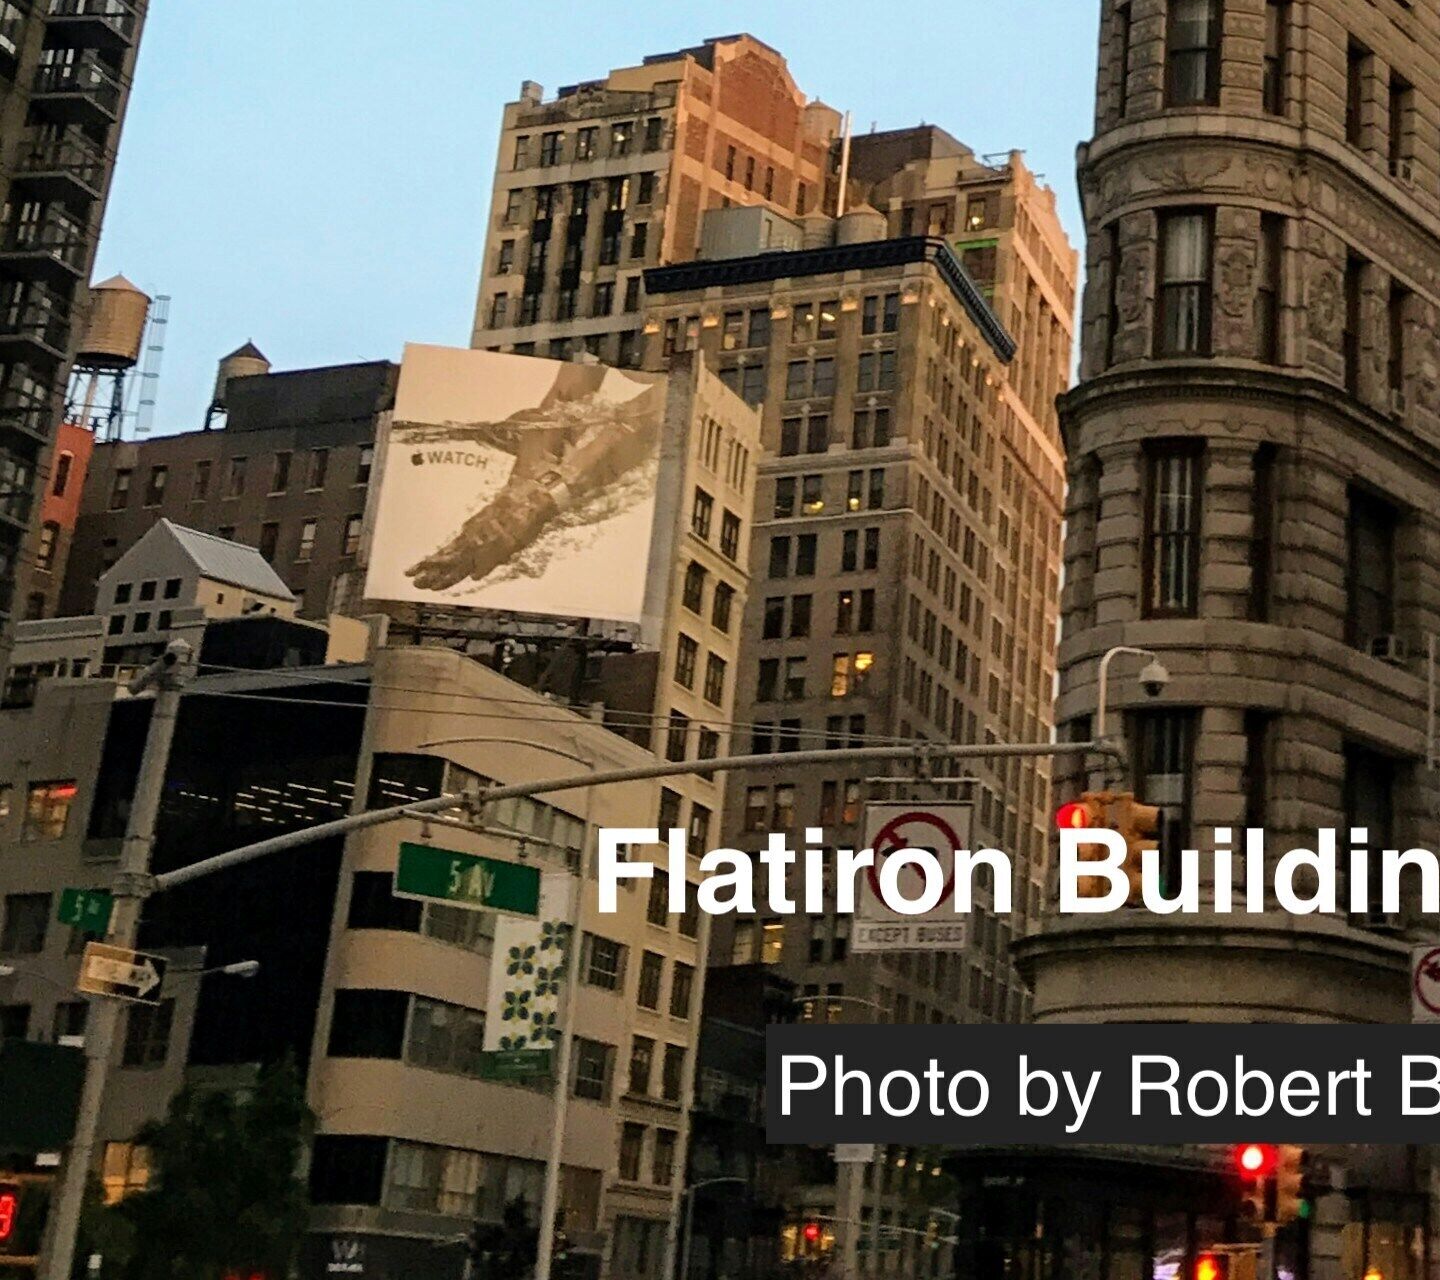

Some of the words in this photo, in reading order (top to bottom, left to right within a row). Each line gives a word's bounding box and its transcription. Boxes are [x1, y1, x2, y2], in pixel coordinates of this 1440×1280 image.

[426, 450, 488, 470] WATCH
[447, 860, 461, 894] 5
[858, 926, 910, 944] EXCEPT
[916, 926, 963, 943] BUSES
